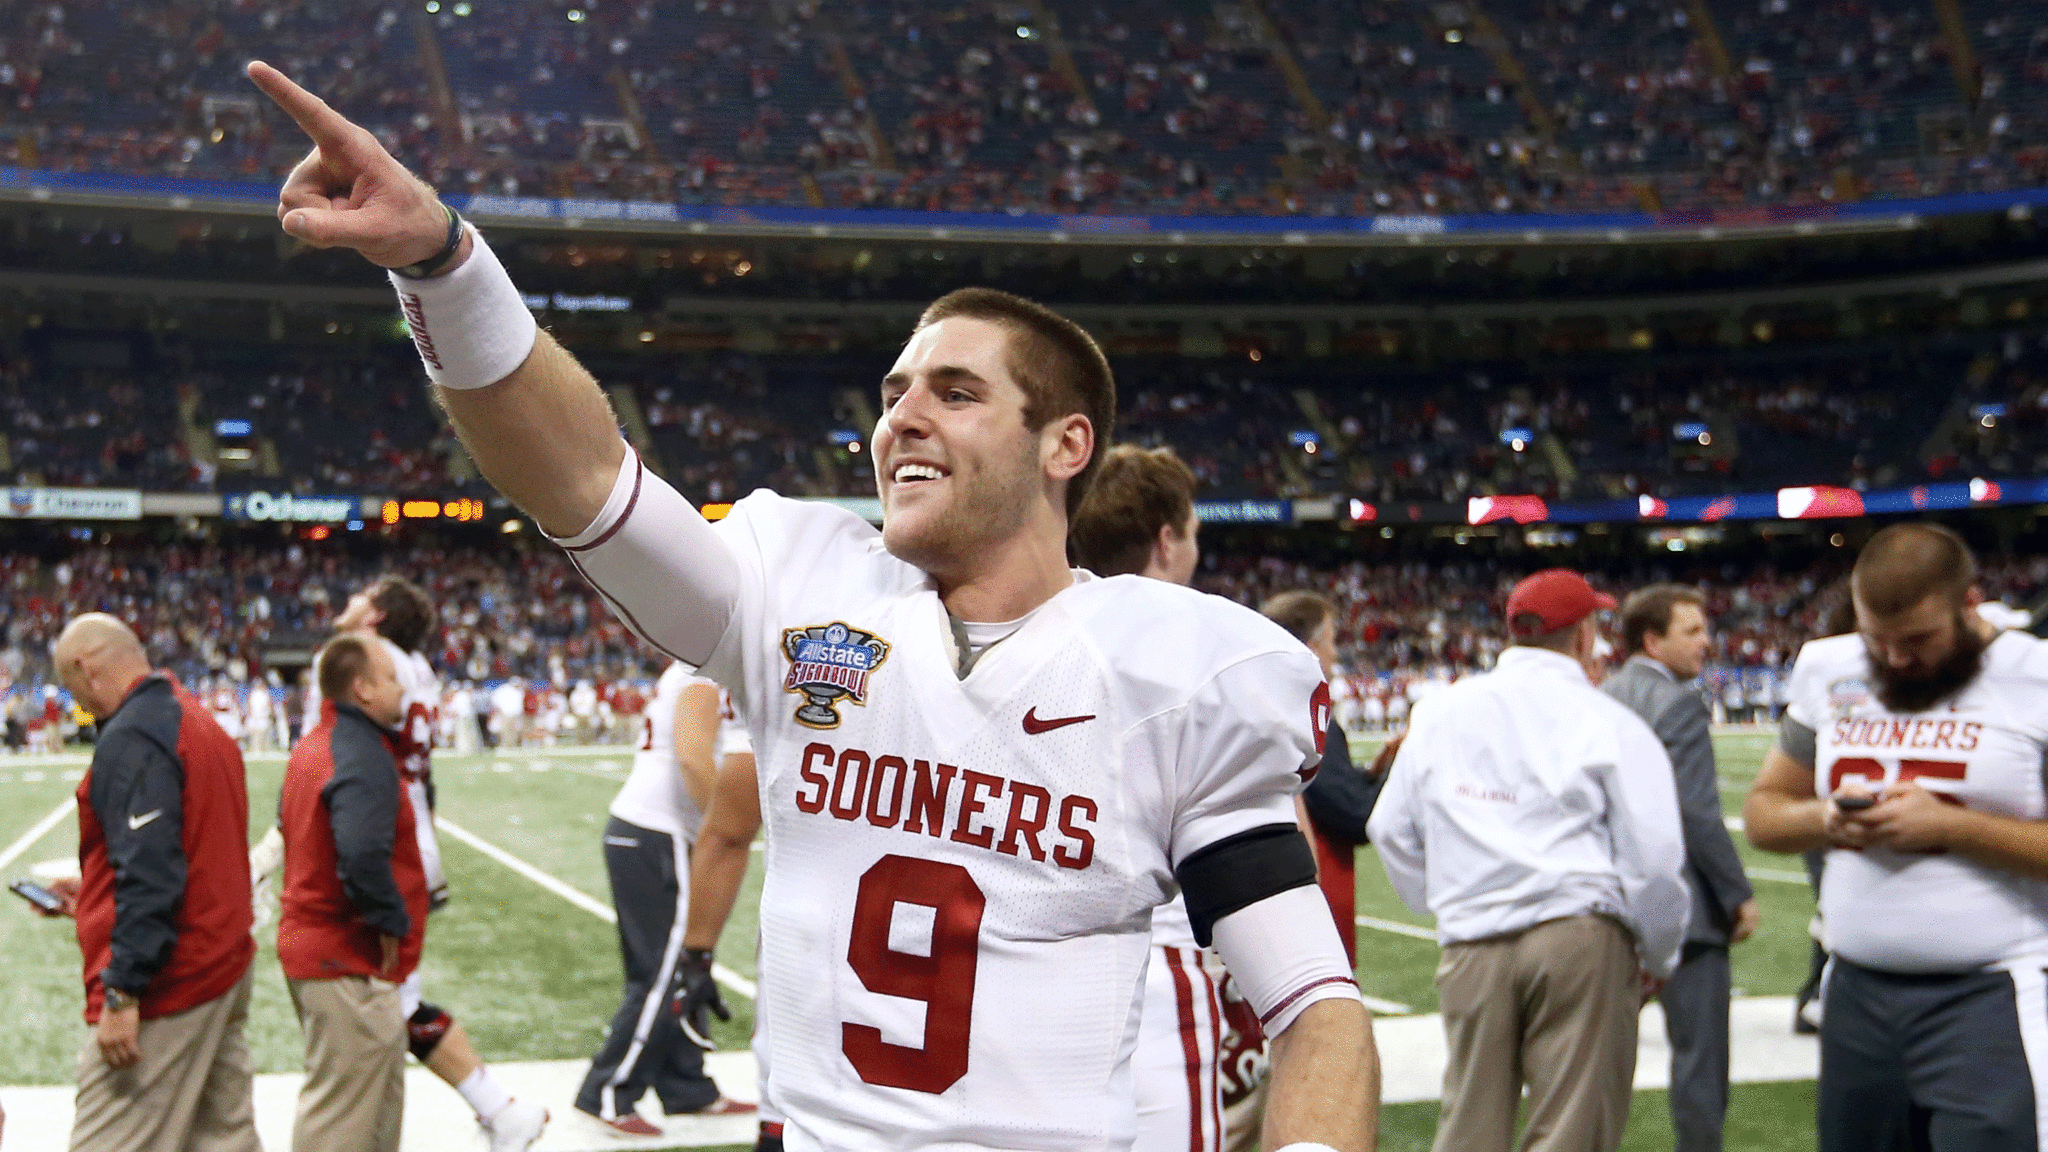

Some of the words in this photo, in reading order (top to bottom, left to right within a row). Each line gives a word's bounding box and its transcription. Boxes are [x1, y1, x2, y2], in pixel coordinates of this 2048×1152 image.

[800, 643, 866, 667] Allstate
[1832, 716, 1984, 751] SOONERS
[796, 742, 1098, 870] SOONERS
[842, 853, 987, 1095] 9
